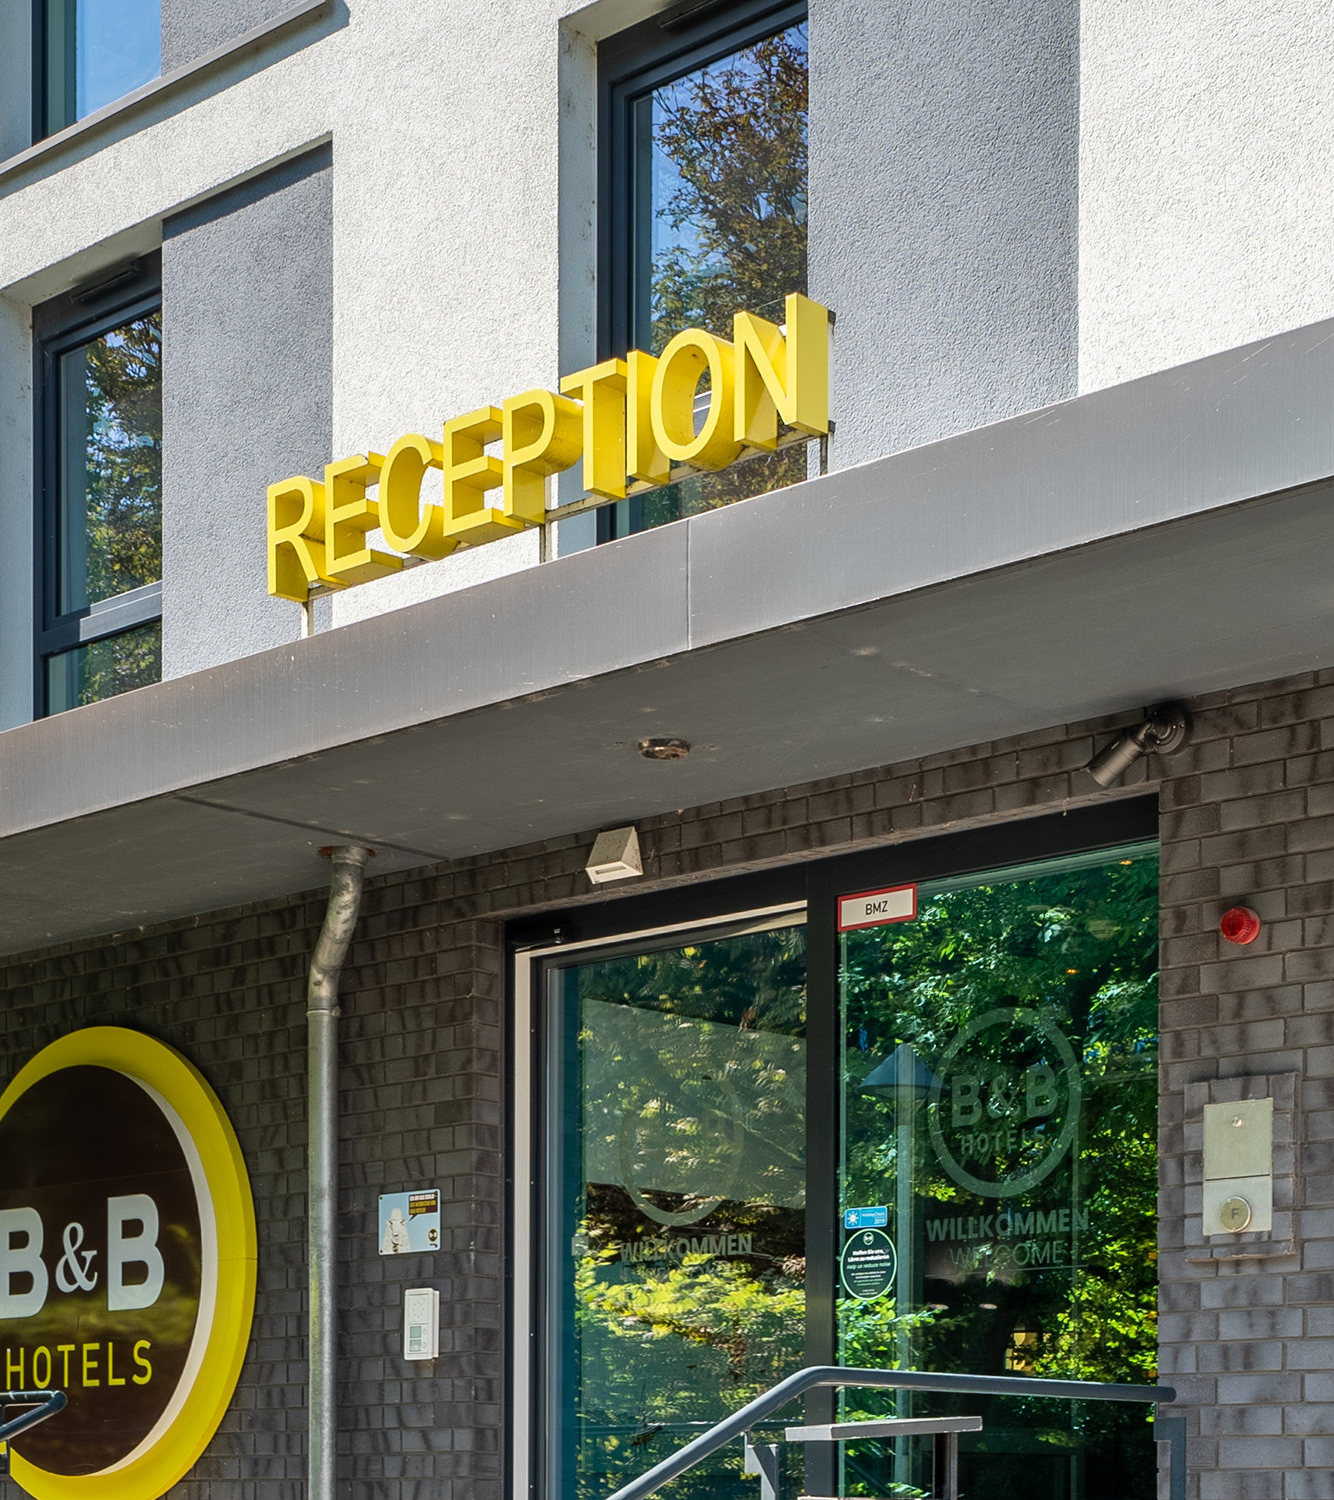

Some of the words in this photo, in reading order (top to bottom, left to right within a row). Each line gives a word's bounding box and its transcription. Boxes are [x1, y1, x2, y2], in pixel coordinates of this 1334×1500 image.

[267, 292, 829, 601] RECEPTION
[865, 900, 888, 916] BMZ
[951, 1063, 1059, 1128] B&B
[960, 1128, 1046, 1155] HOTELS
[925, 1207, 1089, 1242] WILLKOMMEN
[1231, 1207, 1240, 1220] F
[949, 1240, 1064, 1269] WELCOME
[5, 1339, 153, 1391] HOTELS
